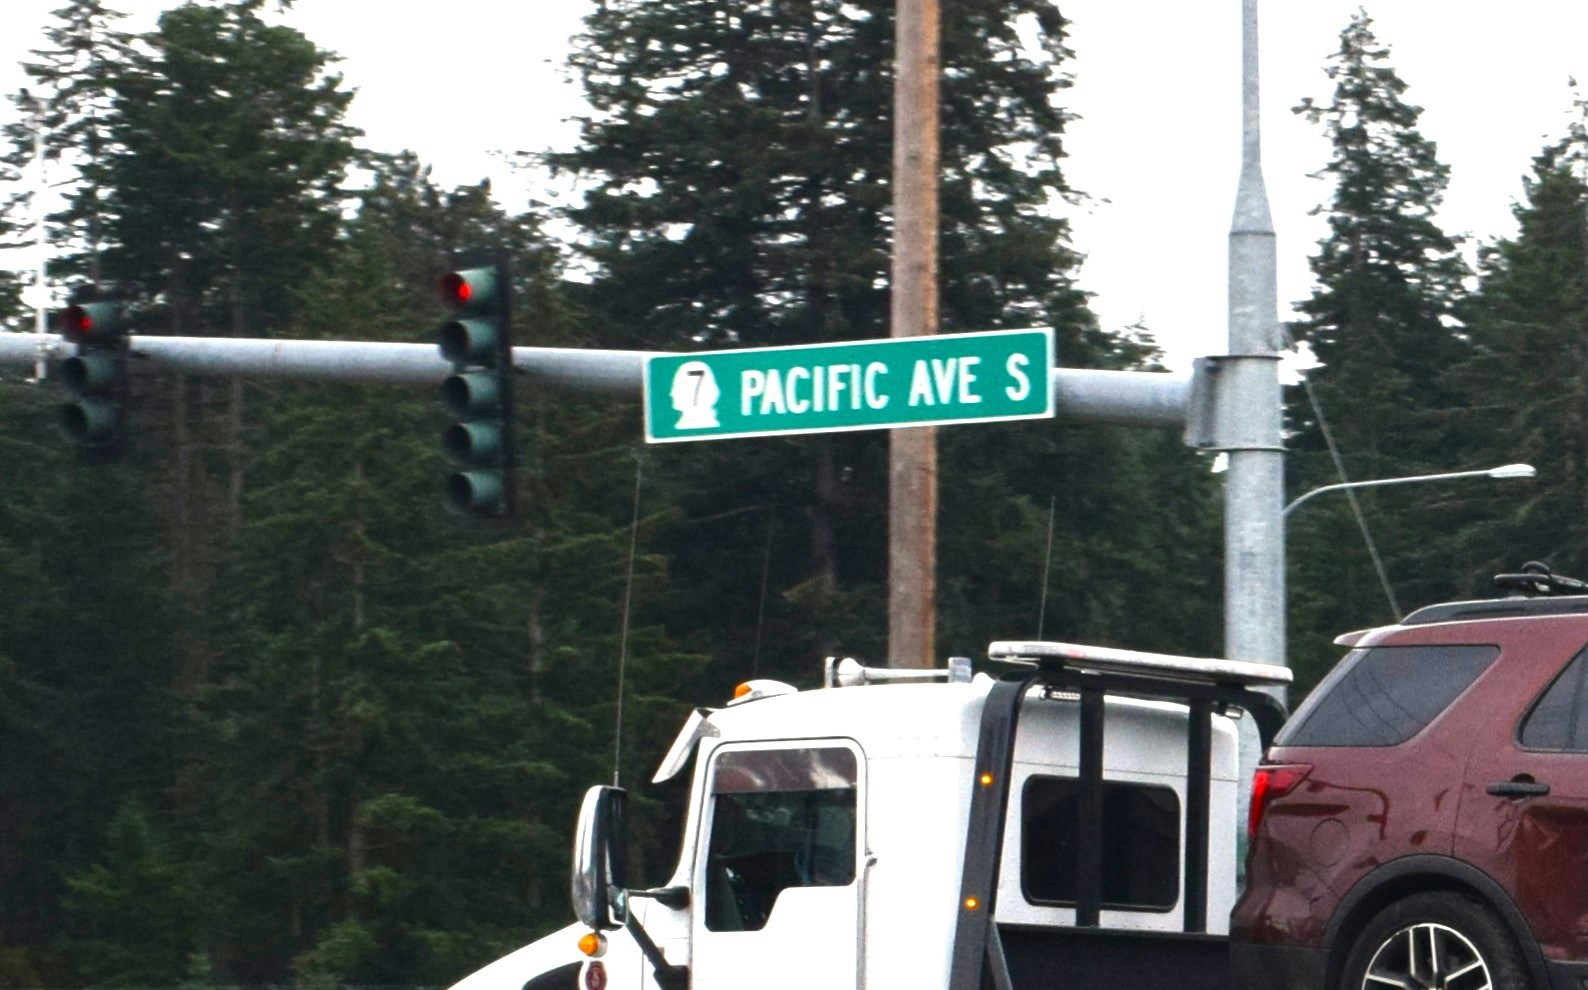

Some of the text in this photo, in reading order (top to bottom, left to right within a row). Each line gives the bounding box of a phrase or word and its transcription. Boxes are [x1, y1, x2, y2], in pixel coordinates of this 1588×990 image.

[686, 369, 706, 407] 7
[740, 352, 1031, 416] PACIFIC AVE S
